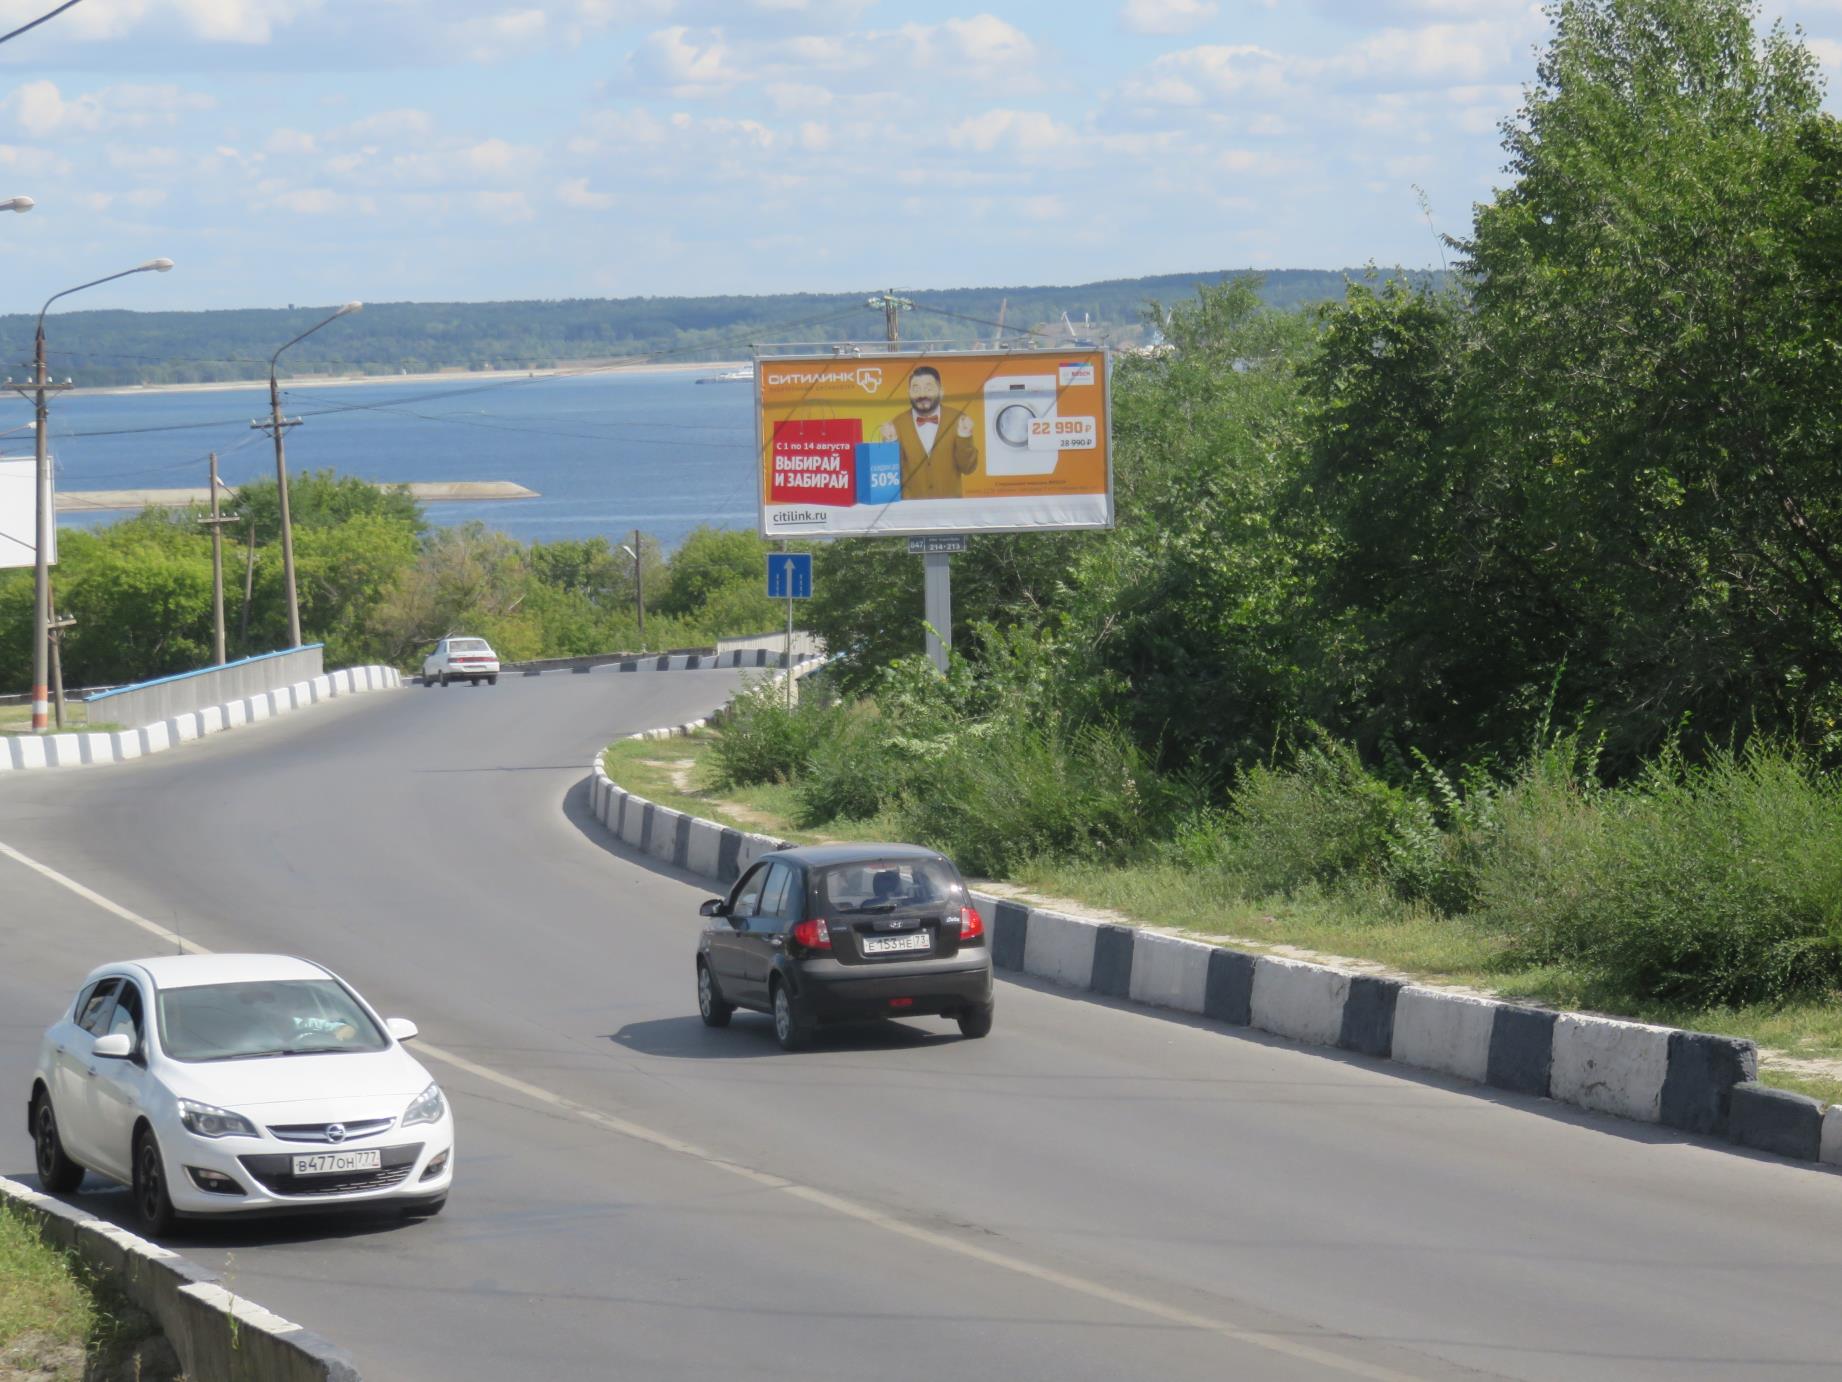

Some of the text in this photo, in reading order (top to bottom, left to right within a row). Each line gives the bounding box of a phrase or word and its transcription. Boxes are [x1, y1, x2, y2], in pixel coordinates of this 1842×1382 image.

[768, 372, 855, 385] СИТИЛИНК
[784, 442, 789, 450] 1
[804, 442, 814, 450] 14
[816, 442, 850, 452] августа
[775, 453, 841, 471] ВЫБИРАЙ
[775, 471, 849, 489] И ЗАБИРАЙ
[871, 471, 900, 488] 50%
[773, 511, 827, 523] citilink.ru
[357, 1151, 377, 1164] 777
